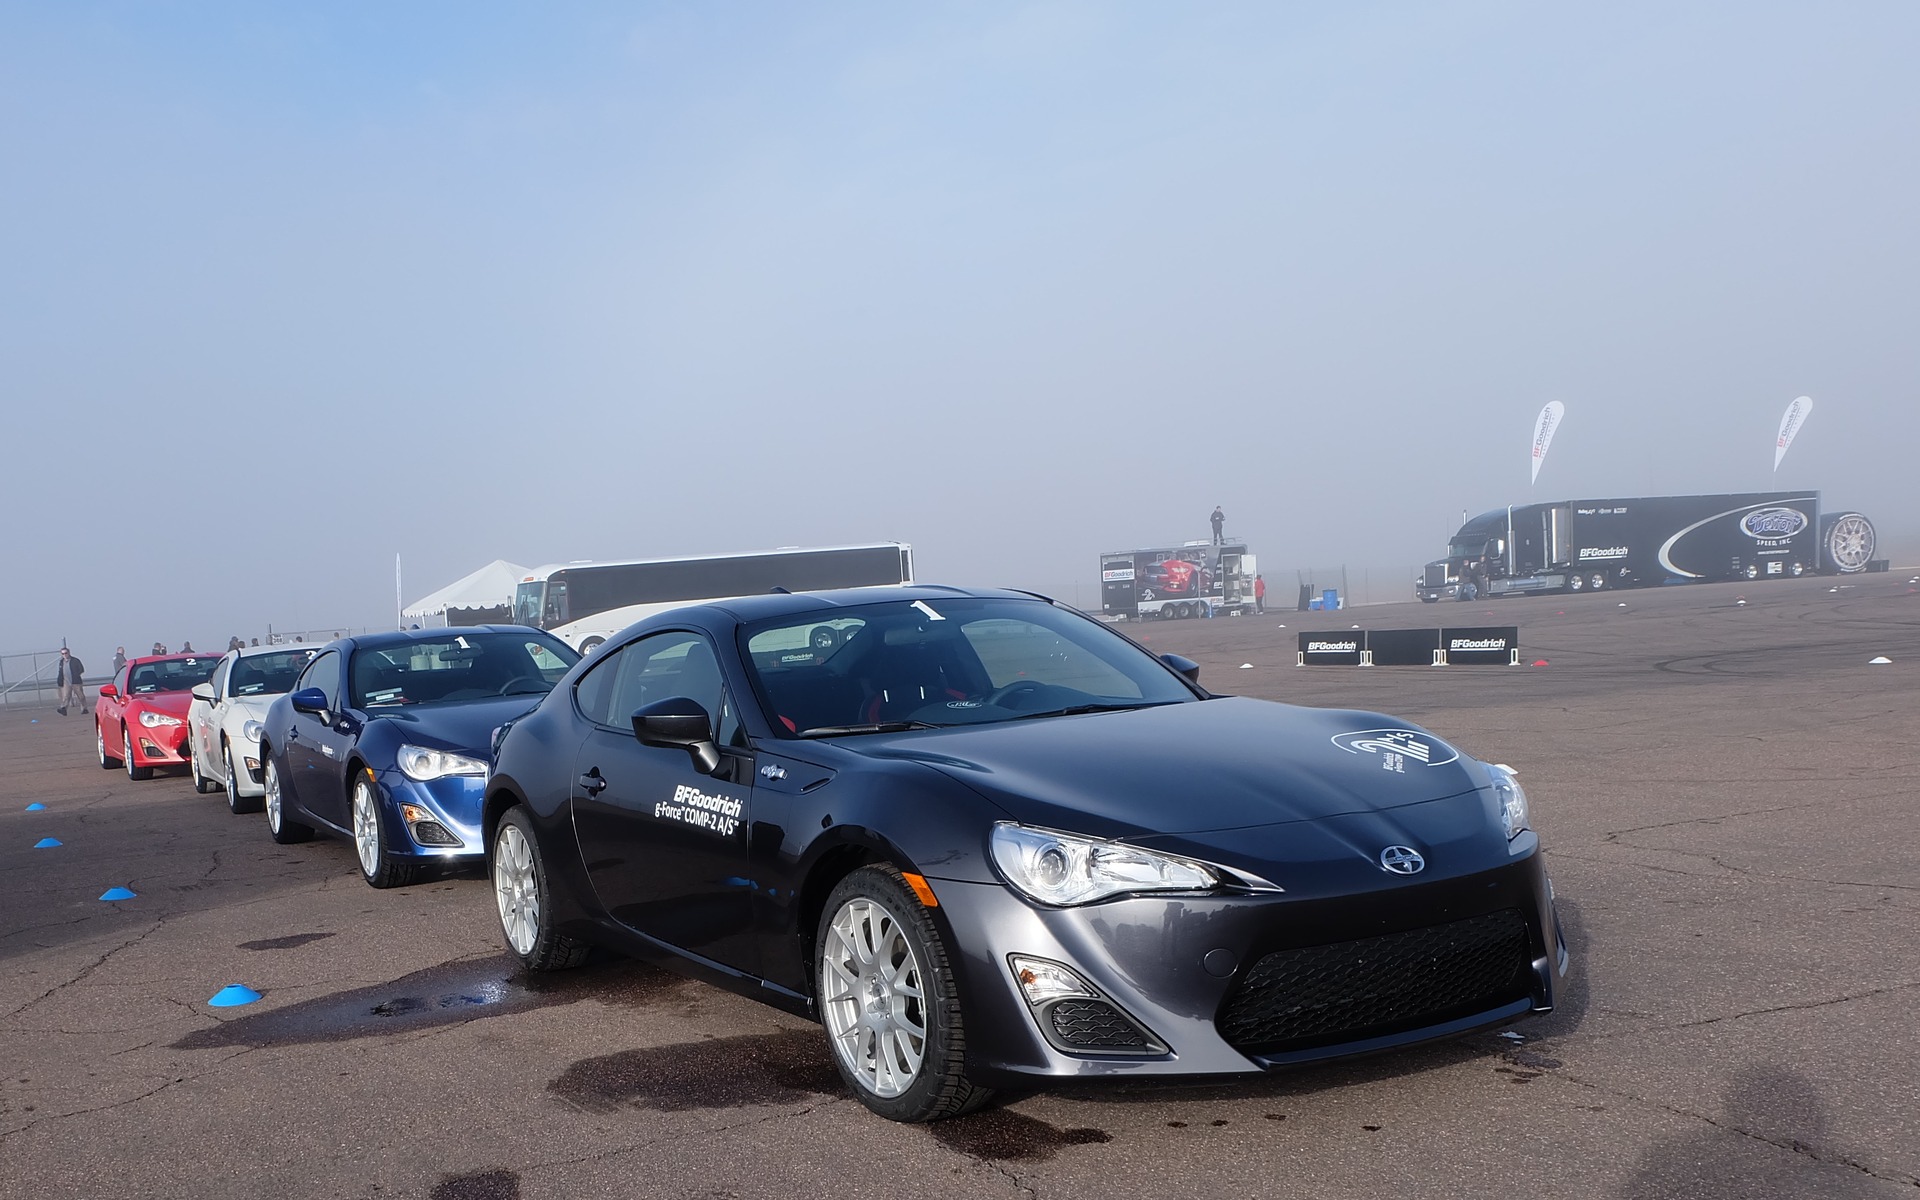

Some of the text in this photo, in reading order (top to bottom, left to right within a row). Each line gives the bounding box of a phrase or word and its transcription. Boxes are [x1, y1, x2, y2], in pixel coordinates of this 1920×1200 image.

[1533, 407, 1551, 458] BFGoodrich
[1580, 547, 1629, 558] BFGoodrich
[909, 600, 946, 621] 1
[454, 636, 471, 649] 1
[1308, 641, 1357, 650] BFGoodrich
[1451, 638, 1505, 649] BFGoodrich
[185, 658, 197, 666] 2
[673, 784, 743, 818] BFGoodrich
[684, 807, 717, 831] COMP-2
